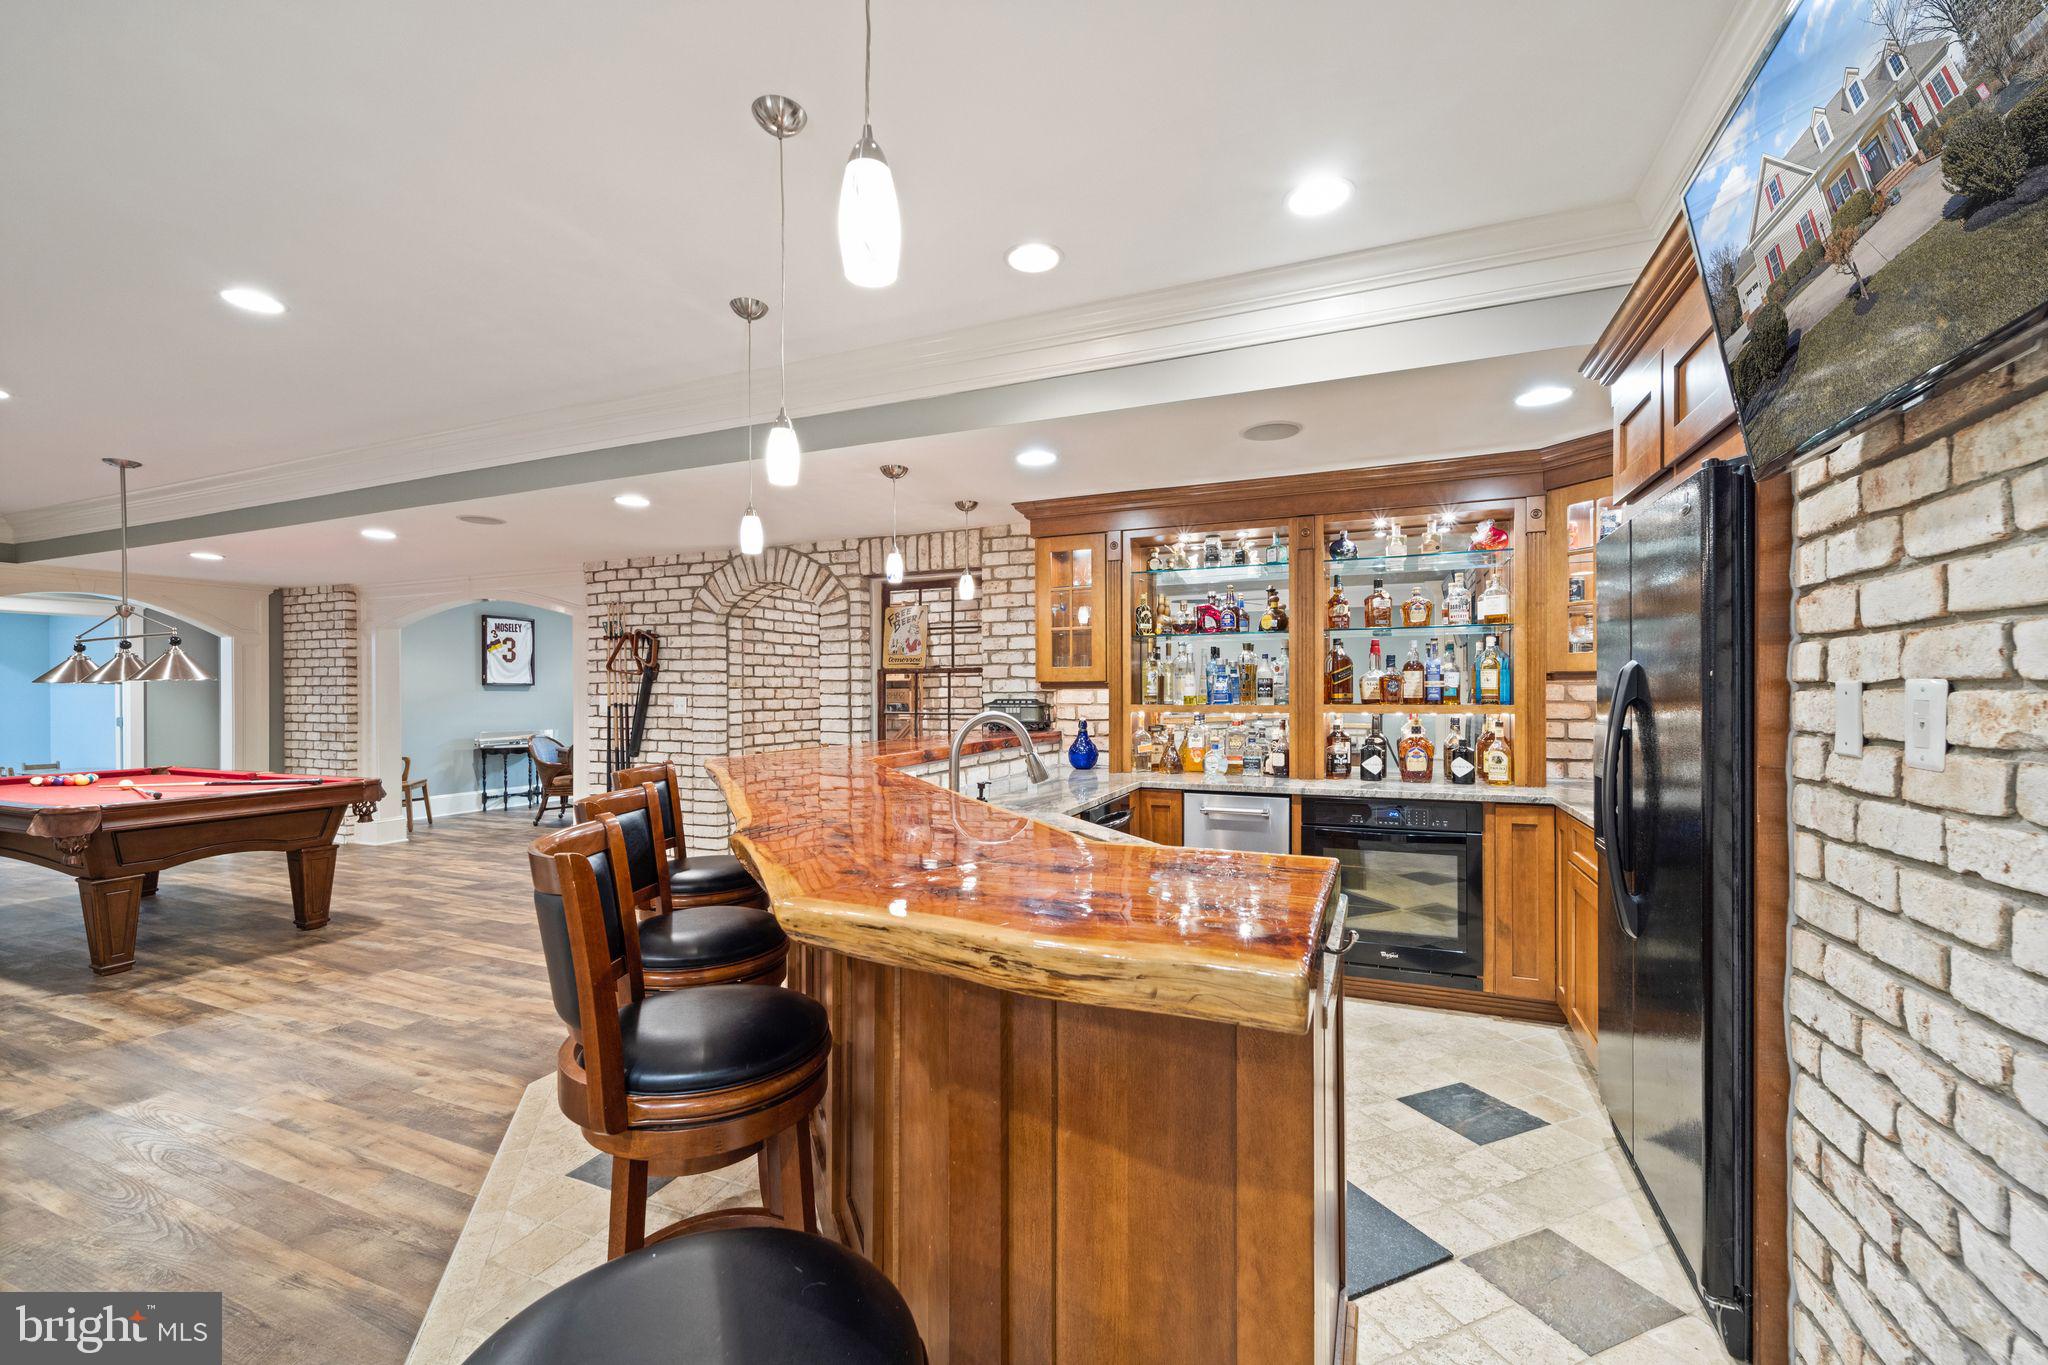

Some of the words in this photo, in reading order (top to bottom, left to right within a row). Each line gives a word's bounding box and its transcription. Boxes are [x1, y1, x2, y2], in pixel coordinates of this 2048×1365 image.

[887, 607, 912, 627] FREE
[491, 629, 499, 639] 3
[494, 623, 522, 632] MOSELEY
[502, 637, 516, 663] 3
